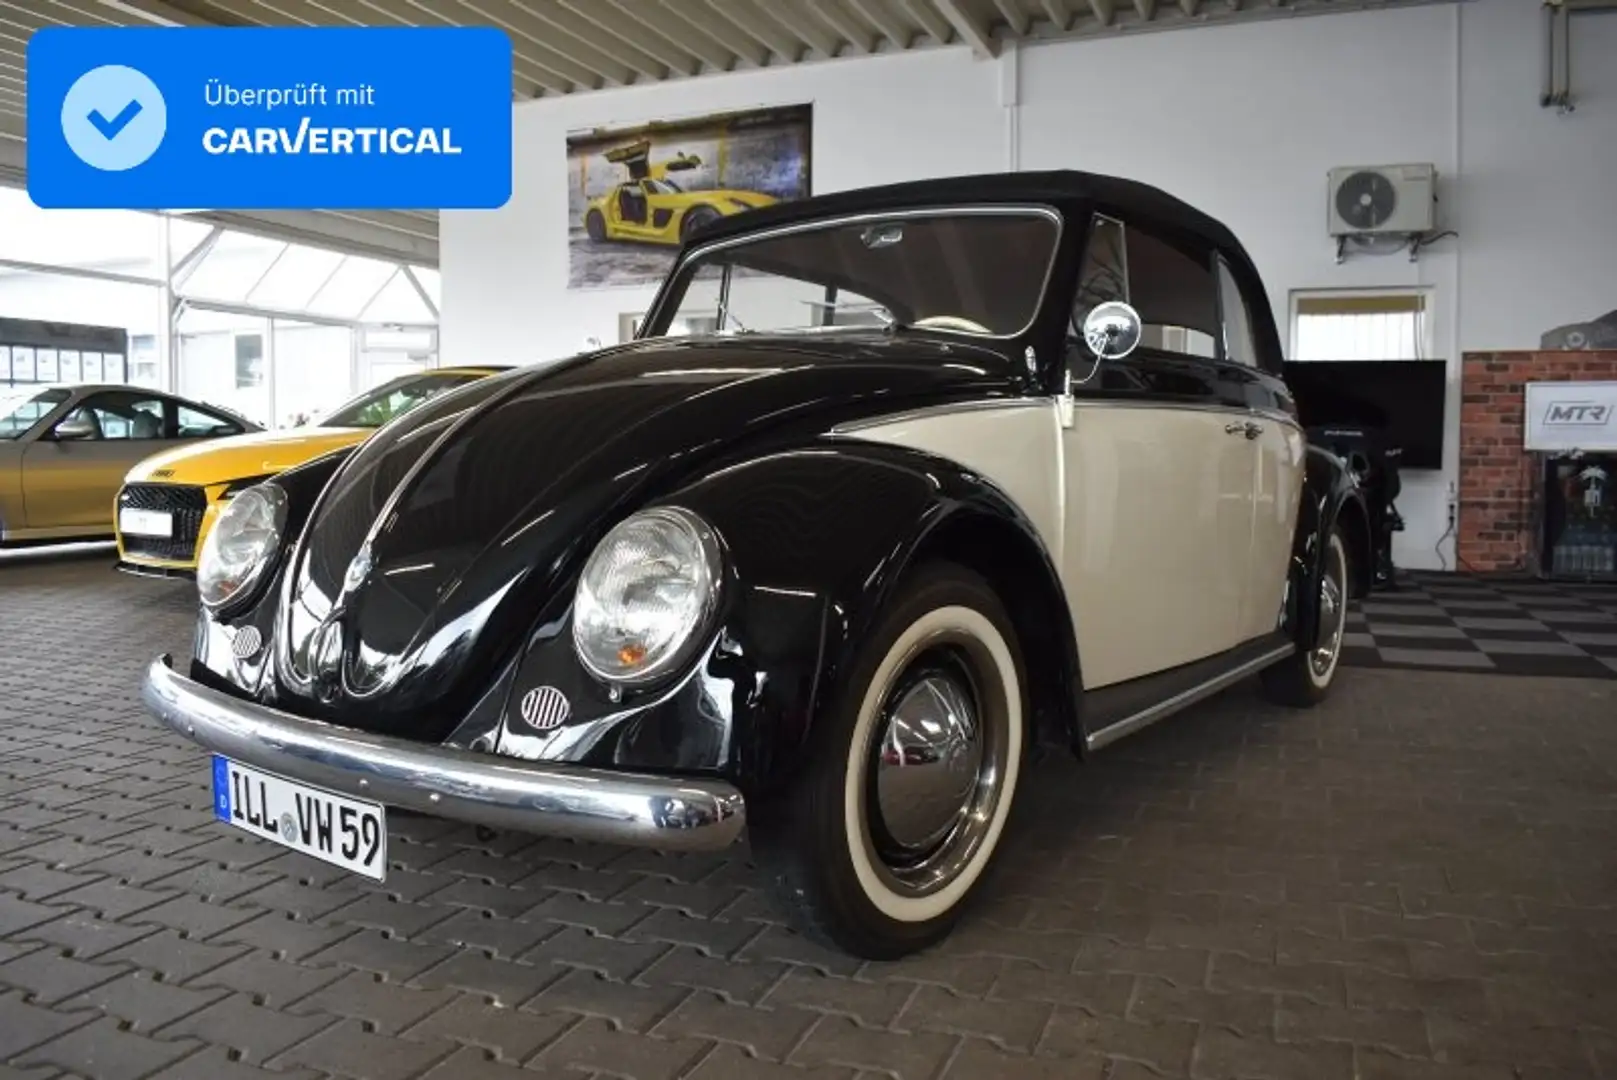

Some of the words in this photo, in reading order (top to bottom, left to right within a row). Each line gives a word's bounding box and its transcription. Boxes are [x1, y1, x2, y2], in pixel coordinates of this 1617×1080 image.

[1550, 405, 1606, 421] MTR
[232, 770, 278, 833] ILL
[295, 793, 333, 854] VW
[340, 805, 380, 867] 59
